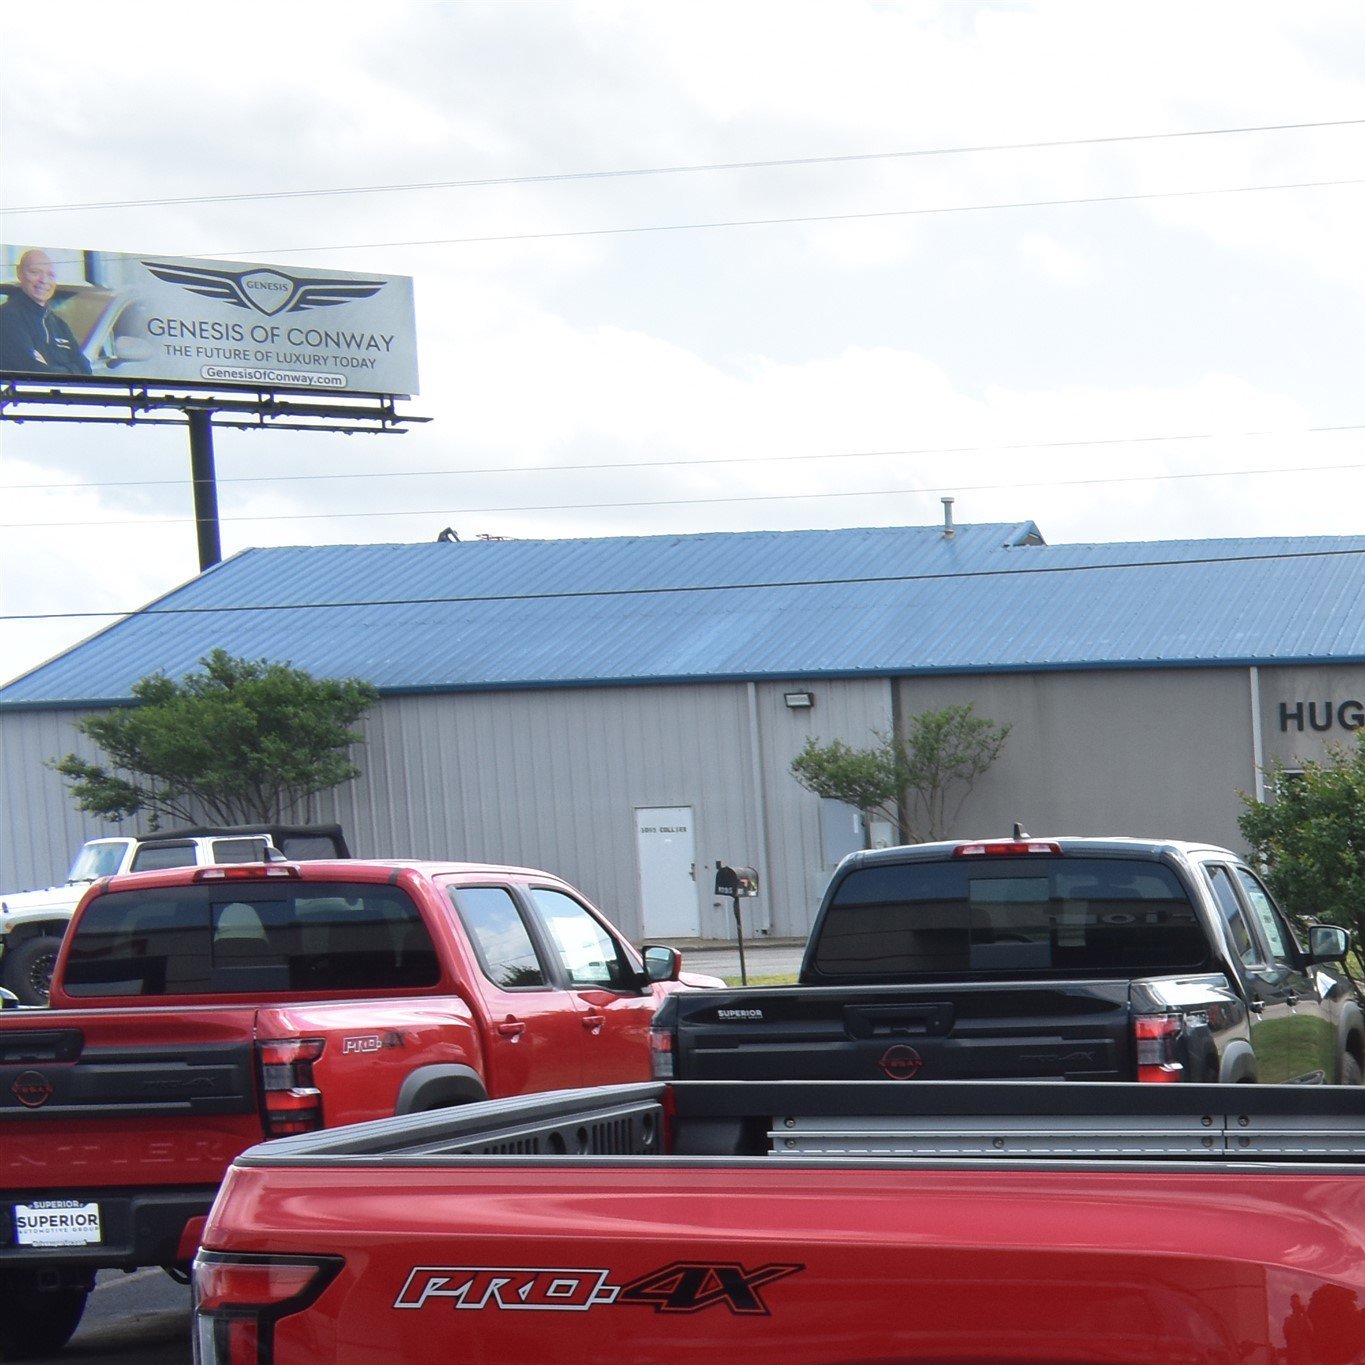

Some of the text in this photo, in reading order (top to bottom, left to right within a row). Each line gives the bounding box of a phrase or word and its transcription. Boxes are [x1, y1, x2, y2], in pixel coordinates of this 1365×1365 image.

[247, 281, 288, 291] GENESIS
[148, 318, 394, 352] GENESIS OF CONWAY
[164, 344, 376, 369] THE FUTURE OF LUXURY TODAY
[206, 367, 342, 386] GenesisOfConway.com
[33, 1200, 79, 1208] SUPERIOR
[18, 1213, 98, 1228] SUPERIOR
